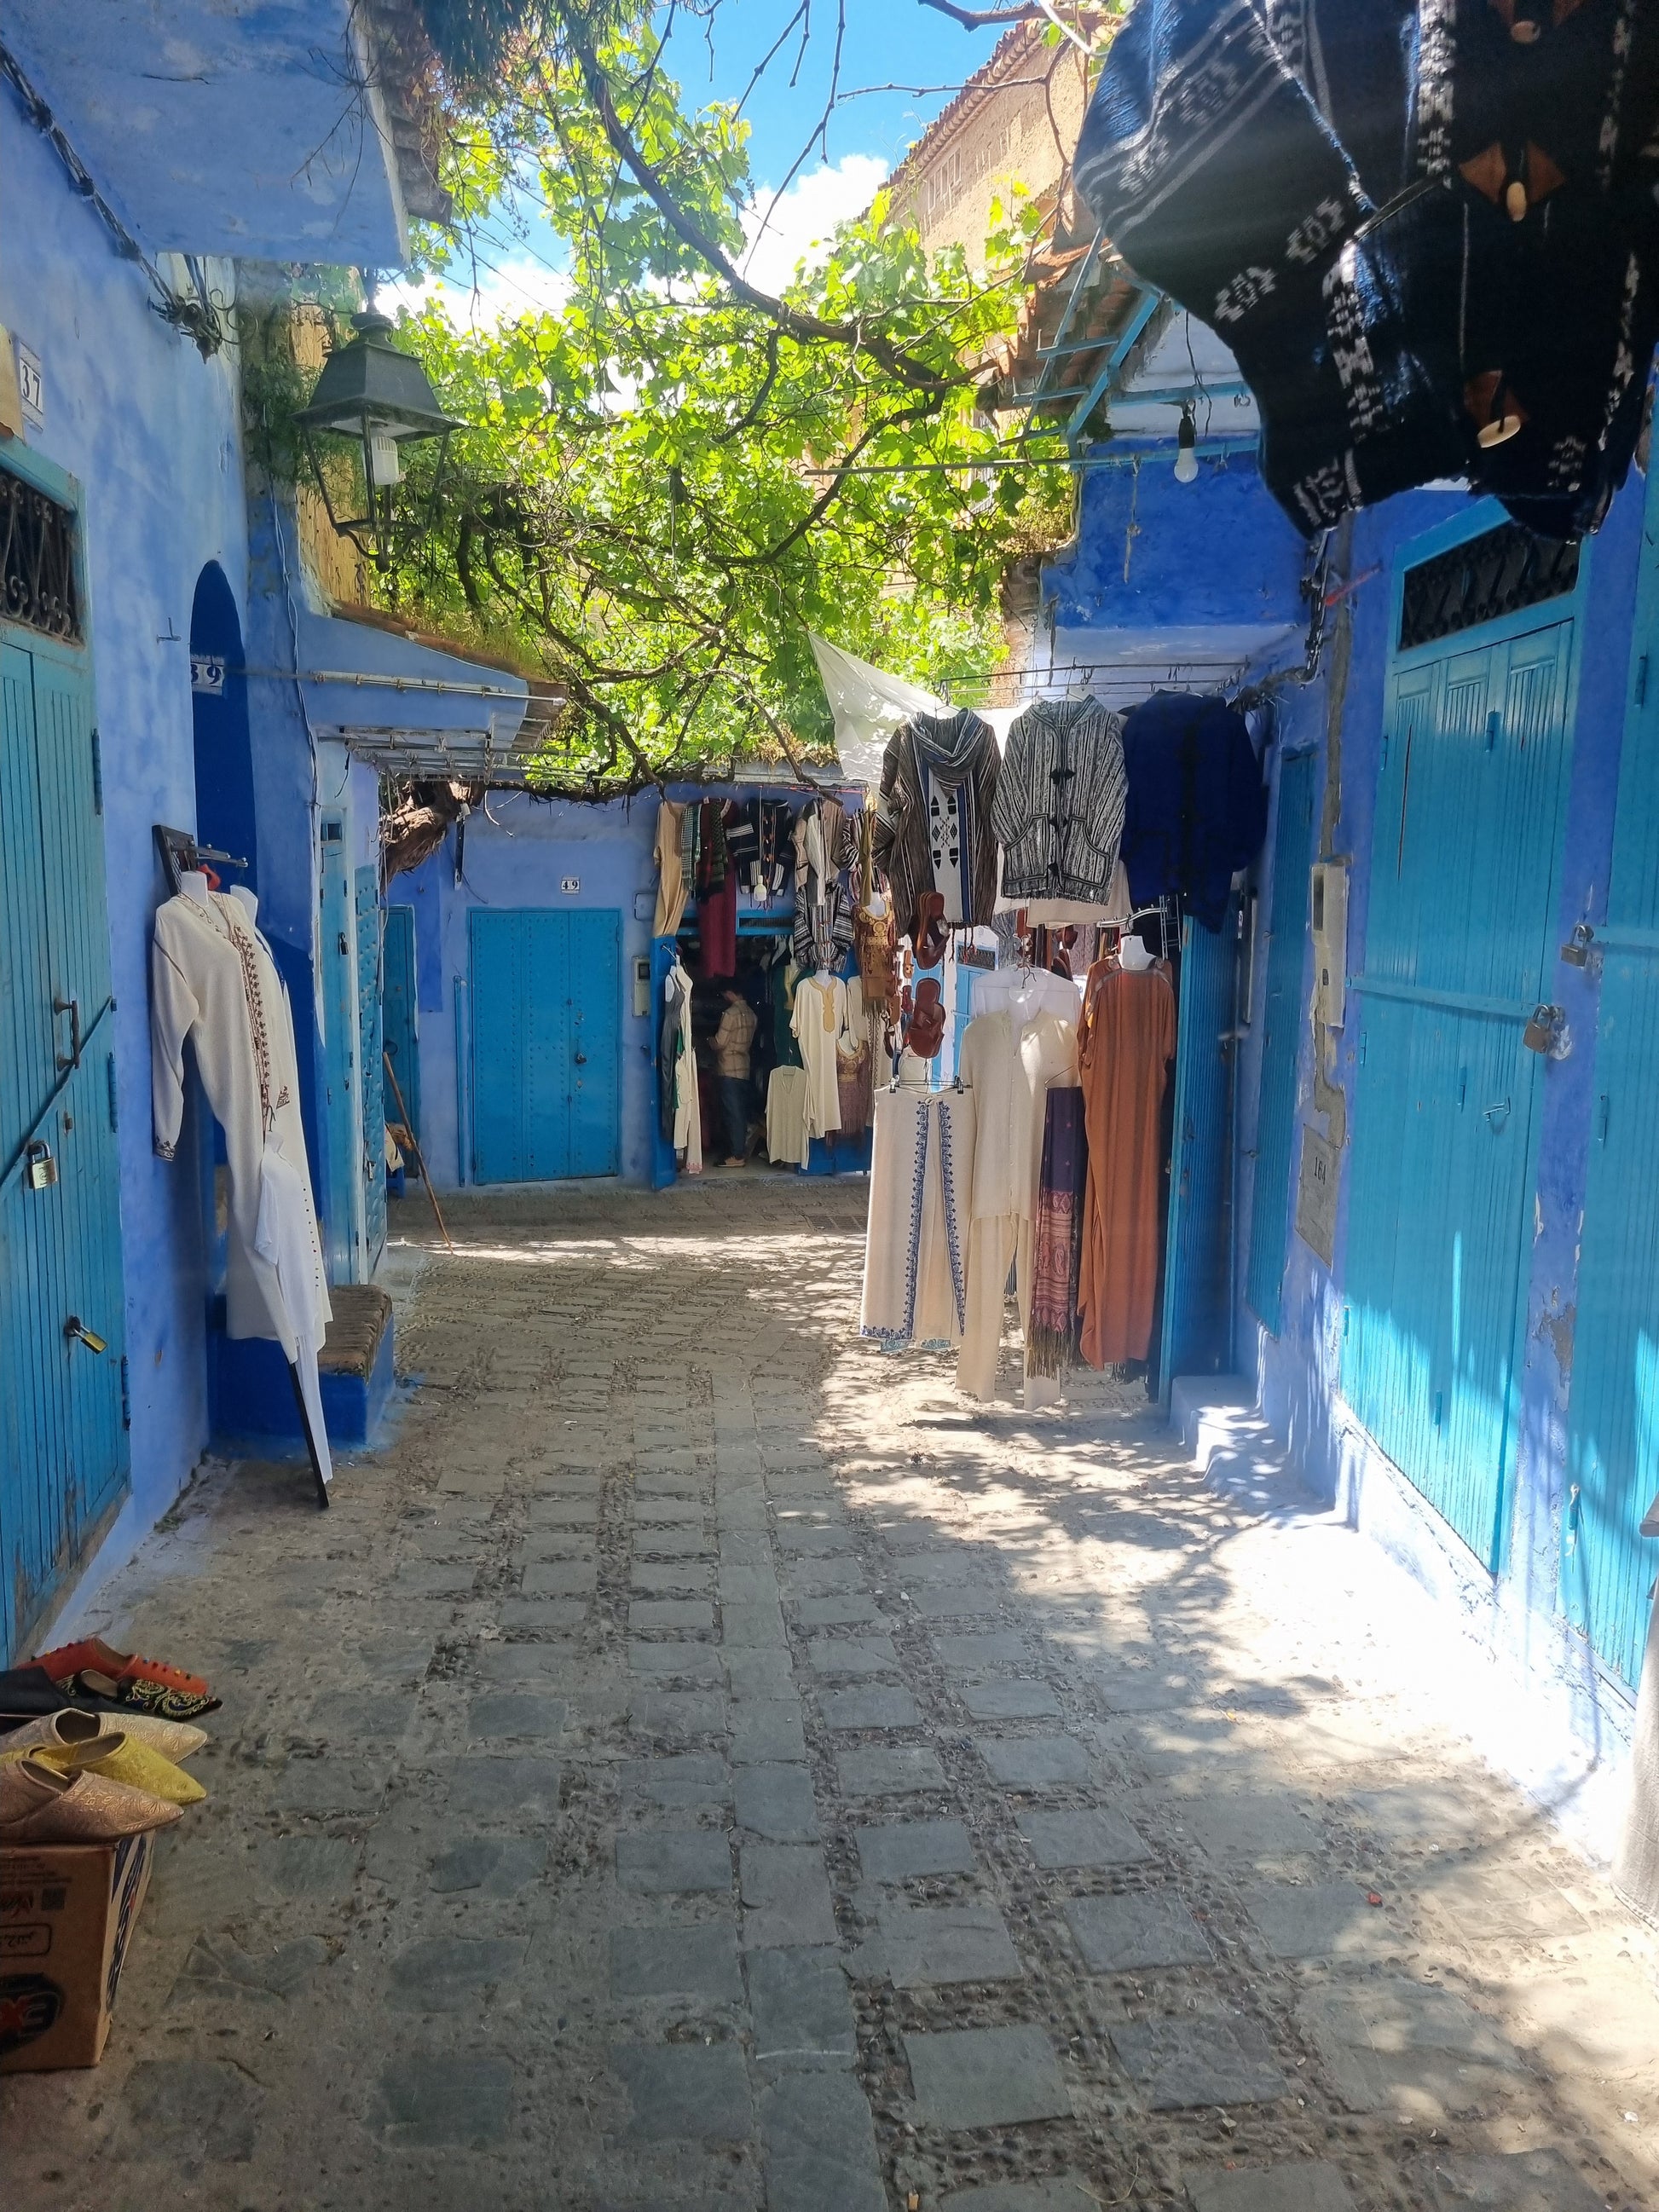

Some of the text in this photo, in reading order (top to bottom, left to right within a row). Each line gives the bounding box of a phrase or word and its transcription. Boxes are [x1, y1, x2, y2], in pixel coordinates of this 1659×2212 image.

[22, 364, 40, 407] 37
[563, 880, 578, 891] 49
[1314, 1156, 1327, 1186] 164
